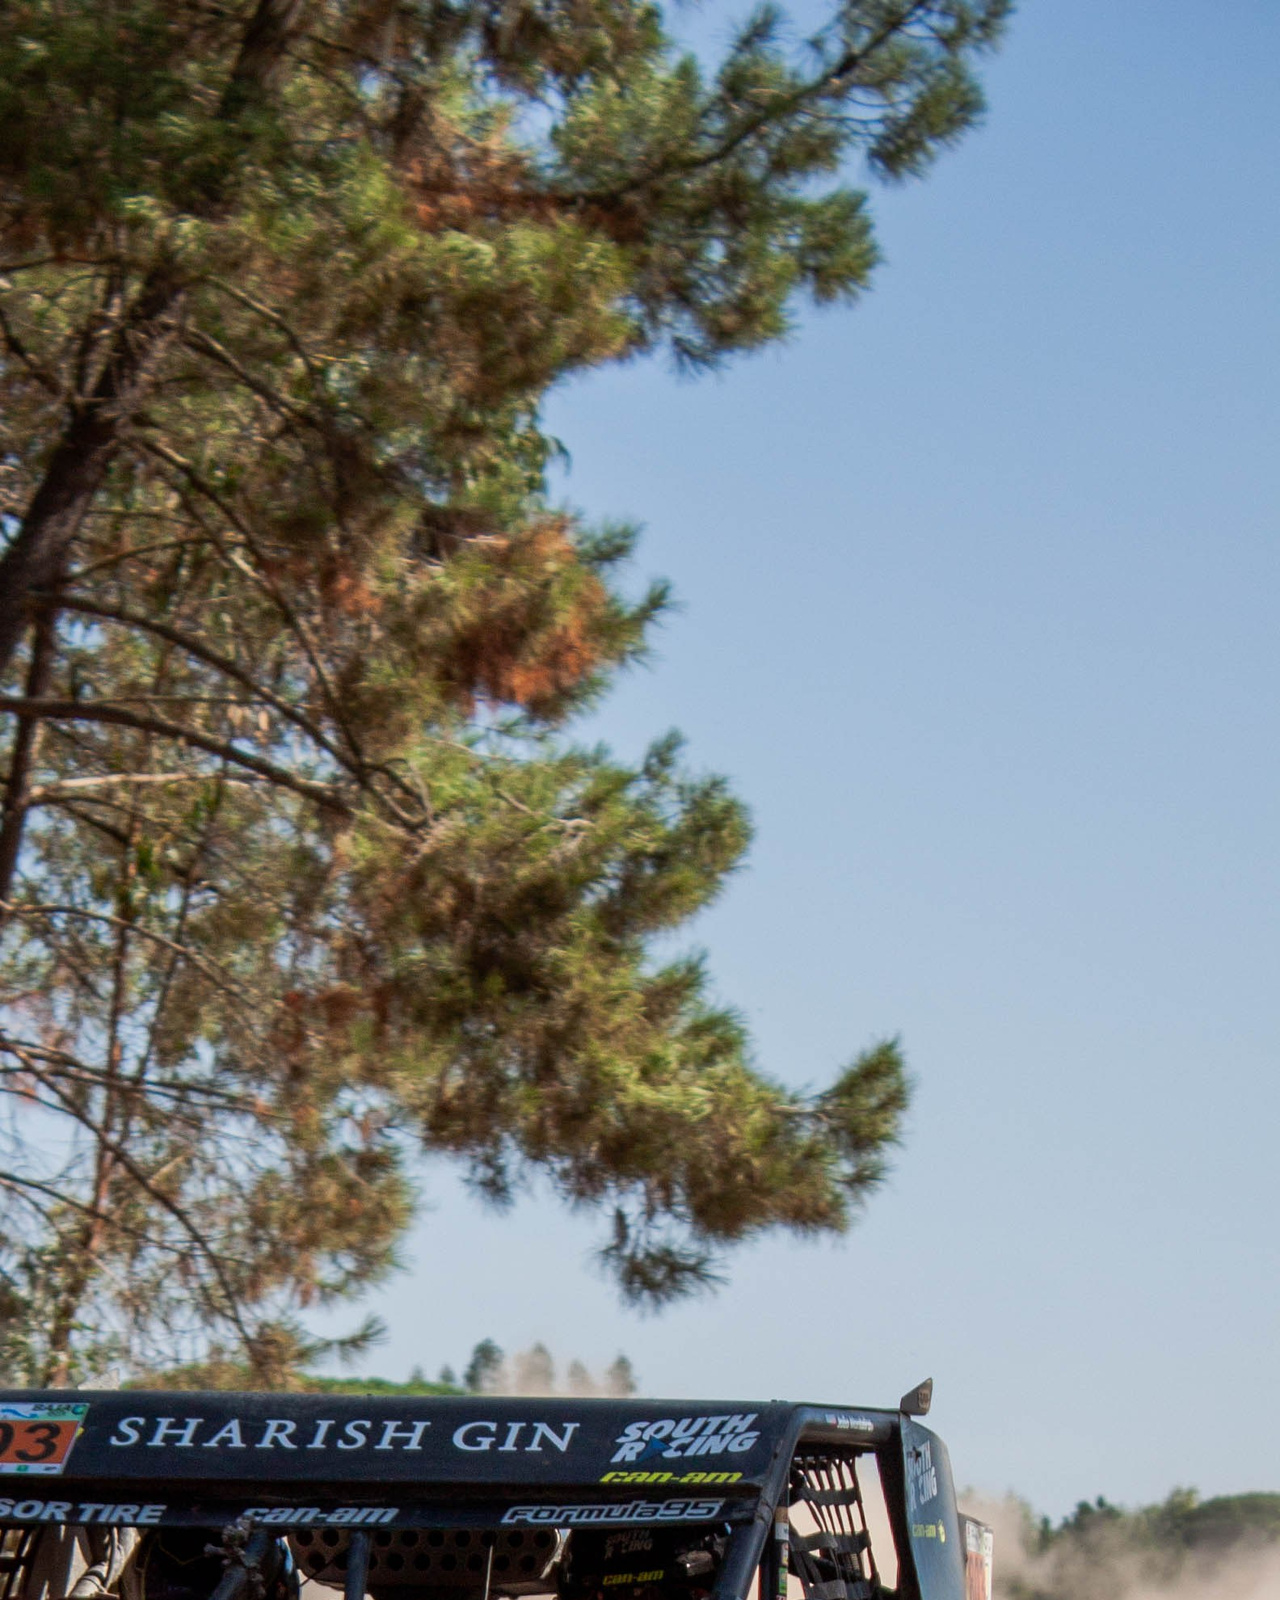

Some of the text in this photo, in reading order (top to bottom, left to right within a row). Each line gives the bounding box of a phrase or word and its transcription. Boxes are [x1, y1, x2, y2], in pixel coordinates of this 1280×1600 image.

[110, 1416, 581, 1453] SHARISH GIN
[615, 1413, 759, 1443] SOUTH
[599, 1471, 744, 1484] can-am
[78, 1503, 168, 1524] TIRE
[242, 1507, 400, 1524] can-am
[502, 1498, 726, 1523] Formula95
[602, 1569, 665, 1587] can-am
